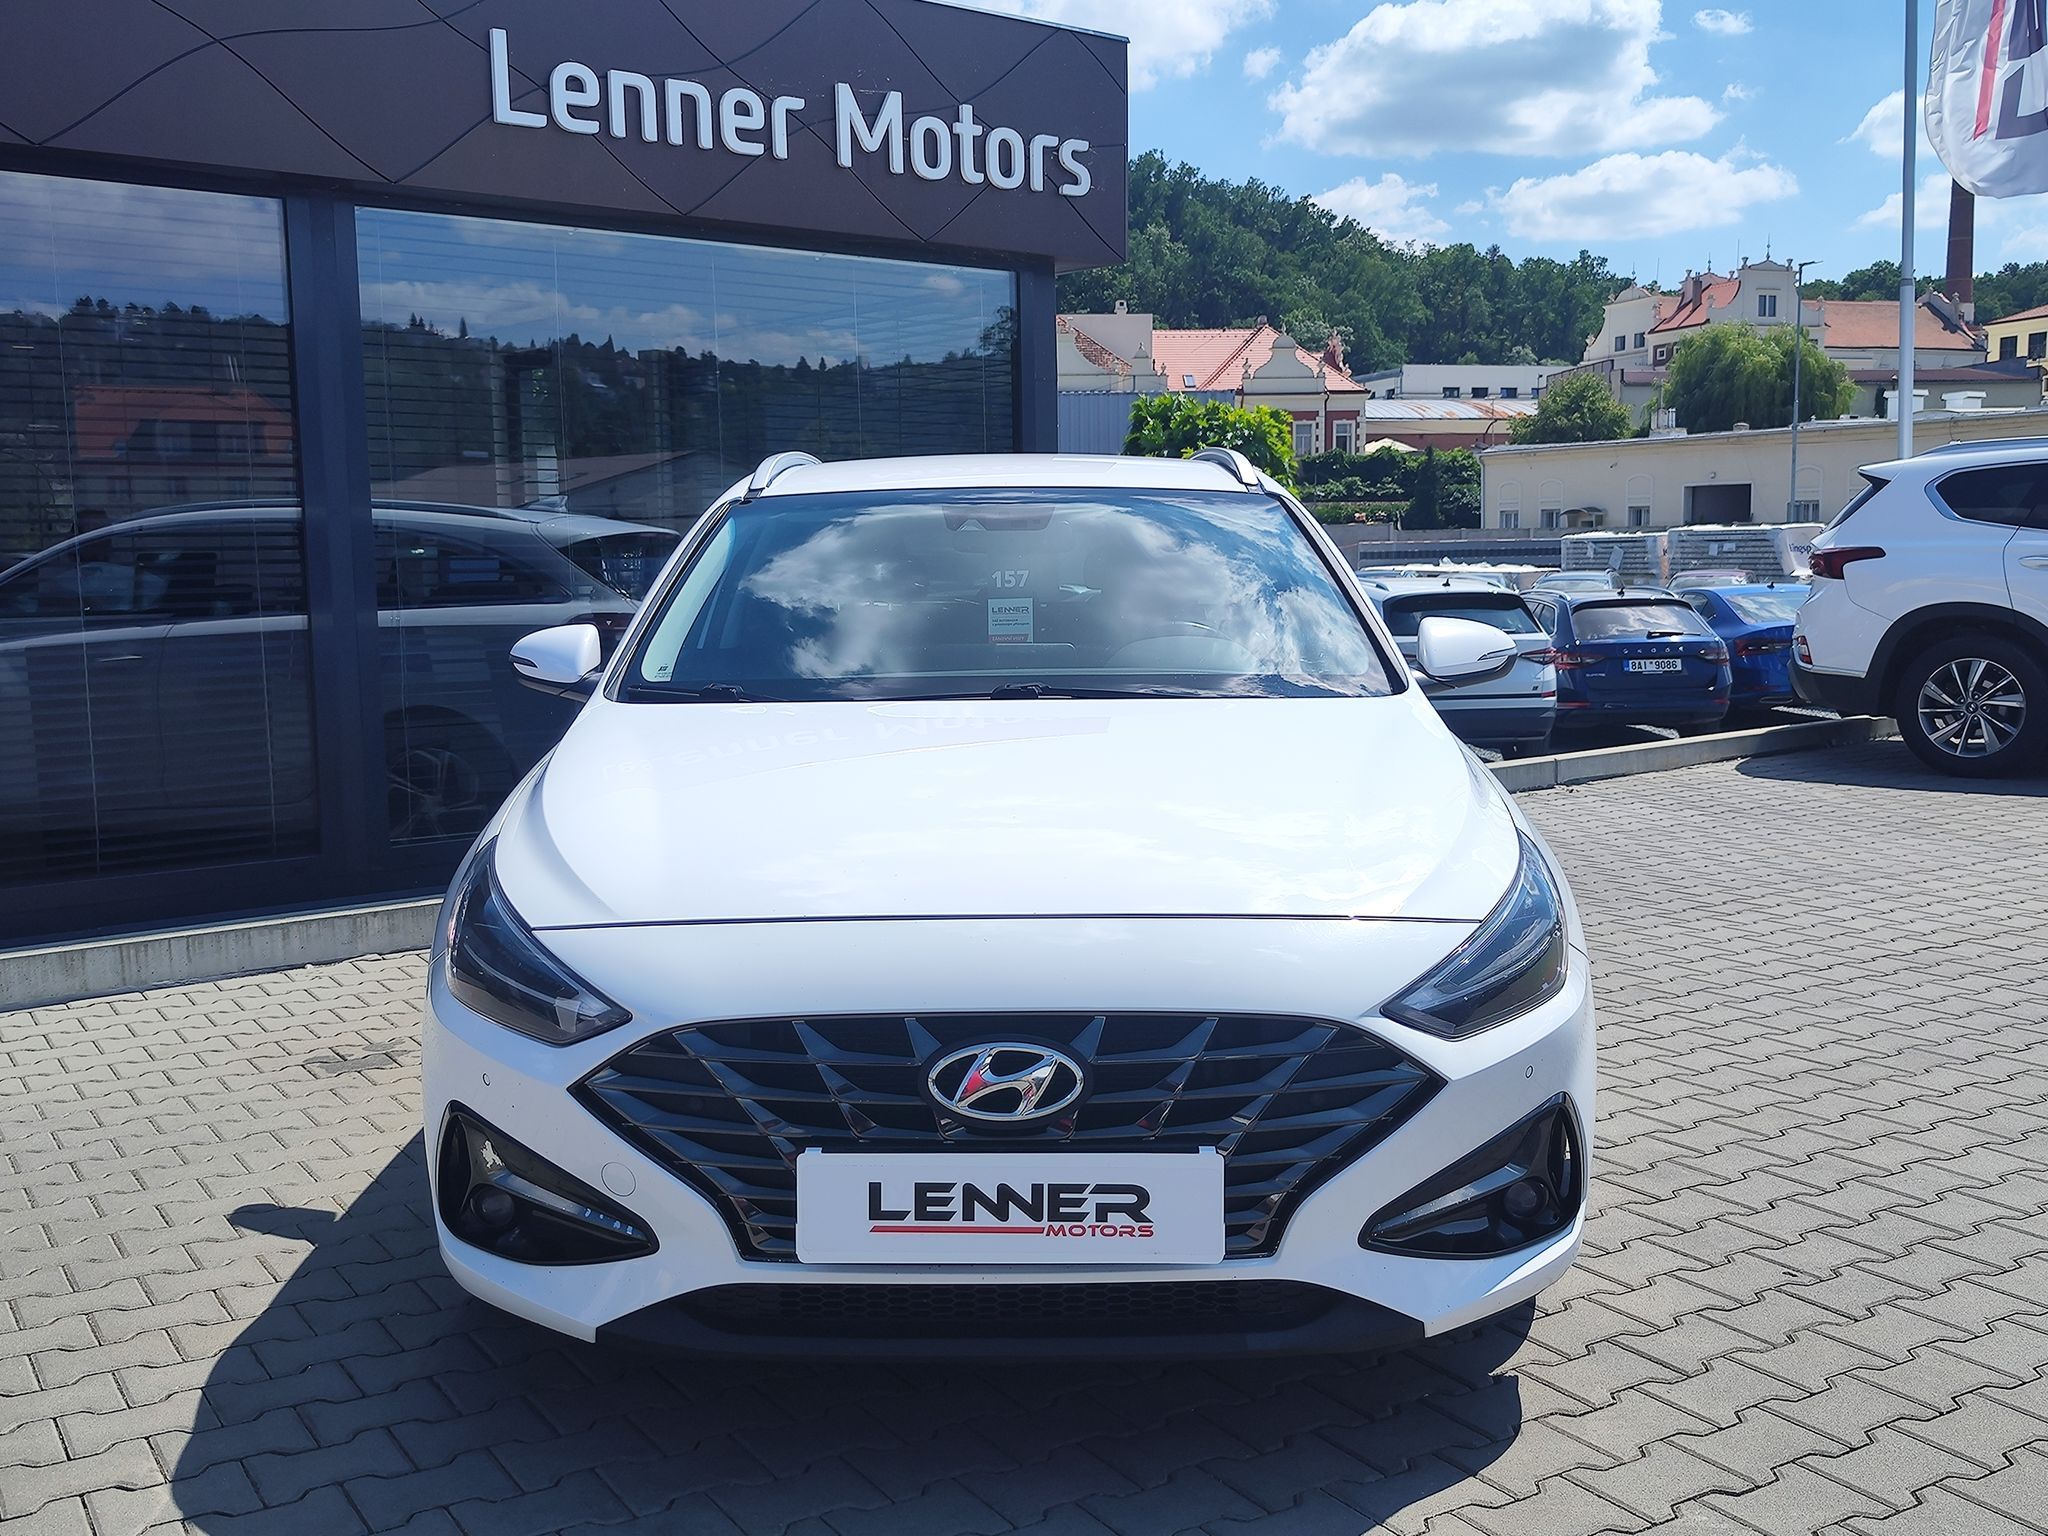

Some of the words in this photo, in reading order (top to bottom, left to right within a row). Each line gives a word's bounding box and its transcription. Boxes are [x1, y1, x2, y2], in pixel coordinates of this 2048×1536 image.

[489, 28, 805, 160] Lenner
[835, 82, 1092, 196] Motors
[991, 569, 1030, 588] 157
[991, 606, 1030, 614] LENNER
[1654, 660, 1678, 670] 9086
[868, 1182, 1154, 1223] LENNER
[1045, 1224, 1154, 1238] MOTORS
